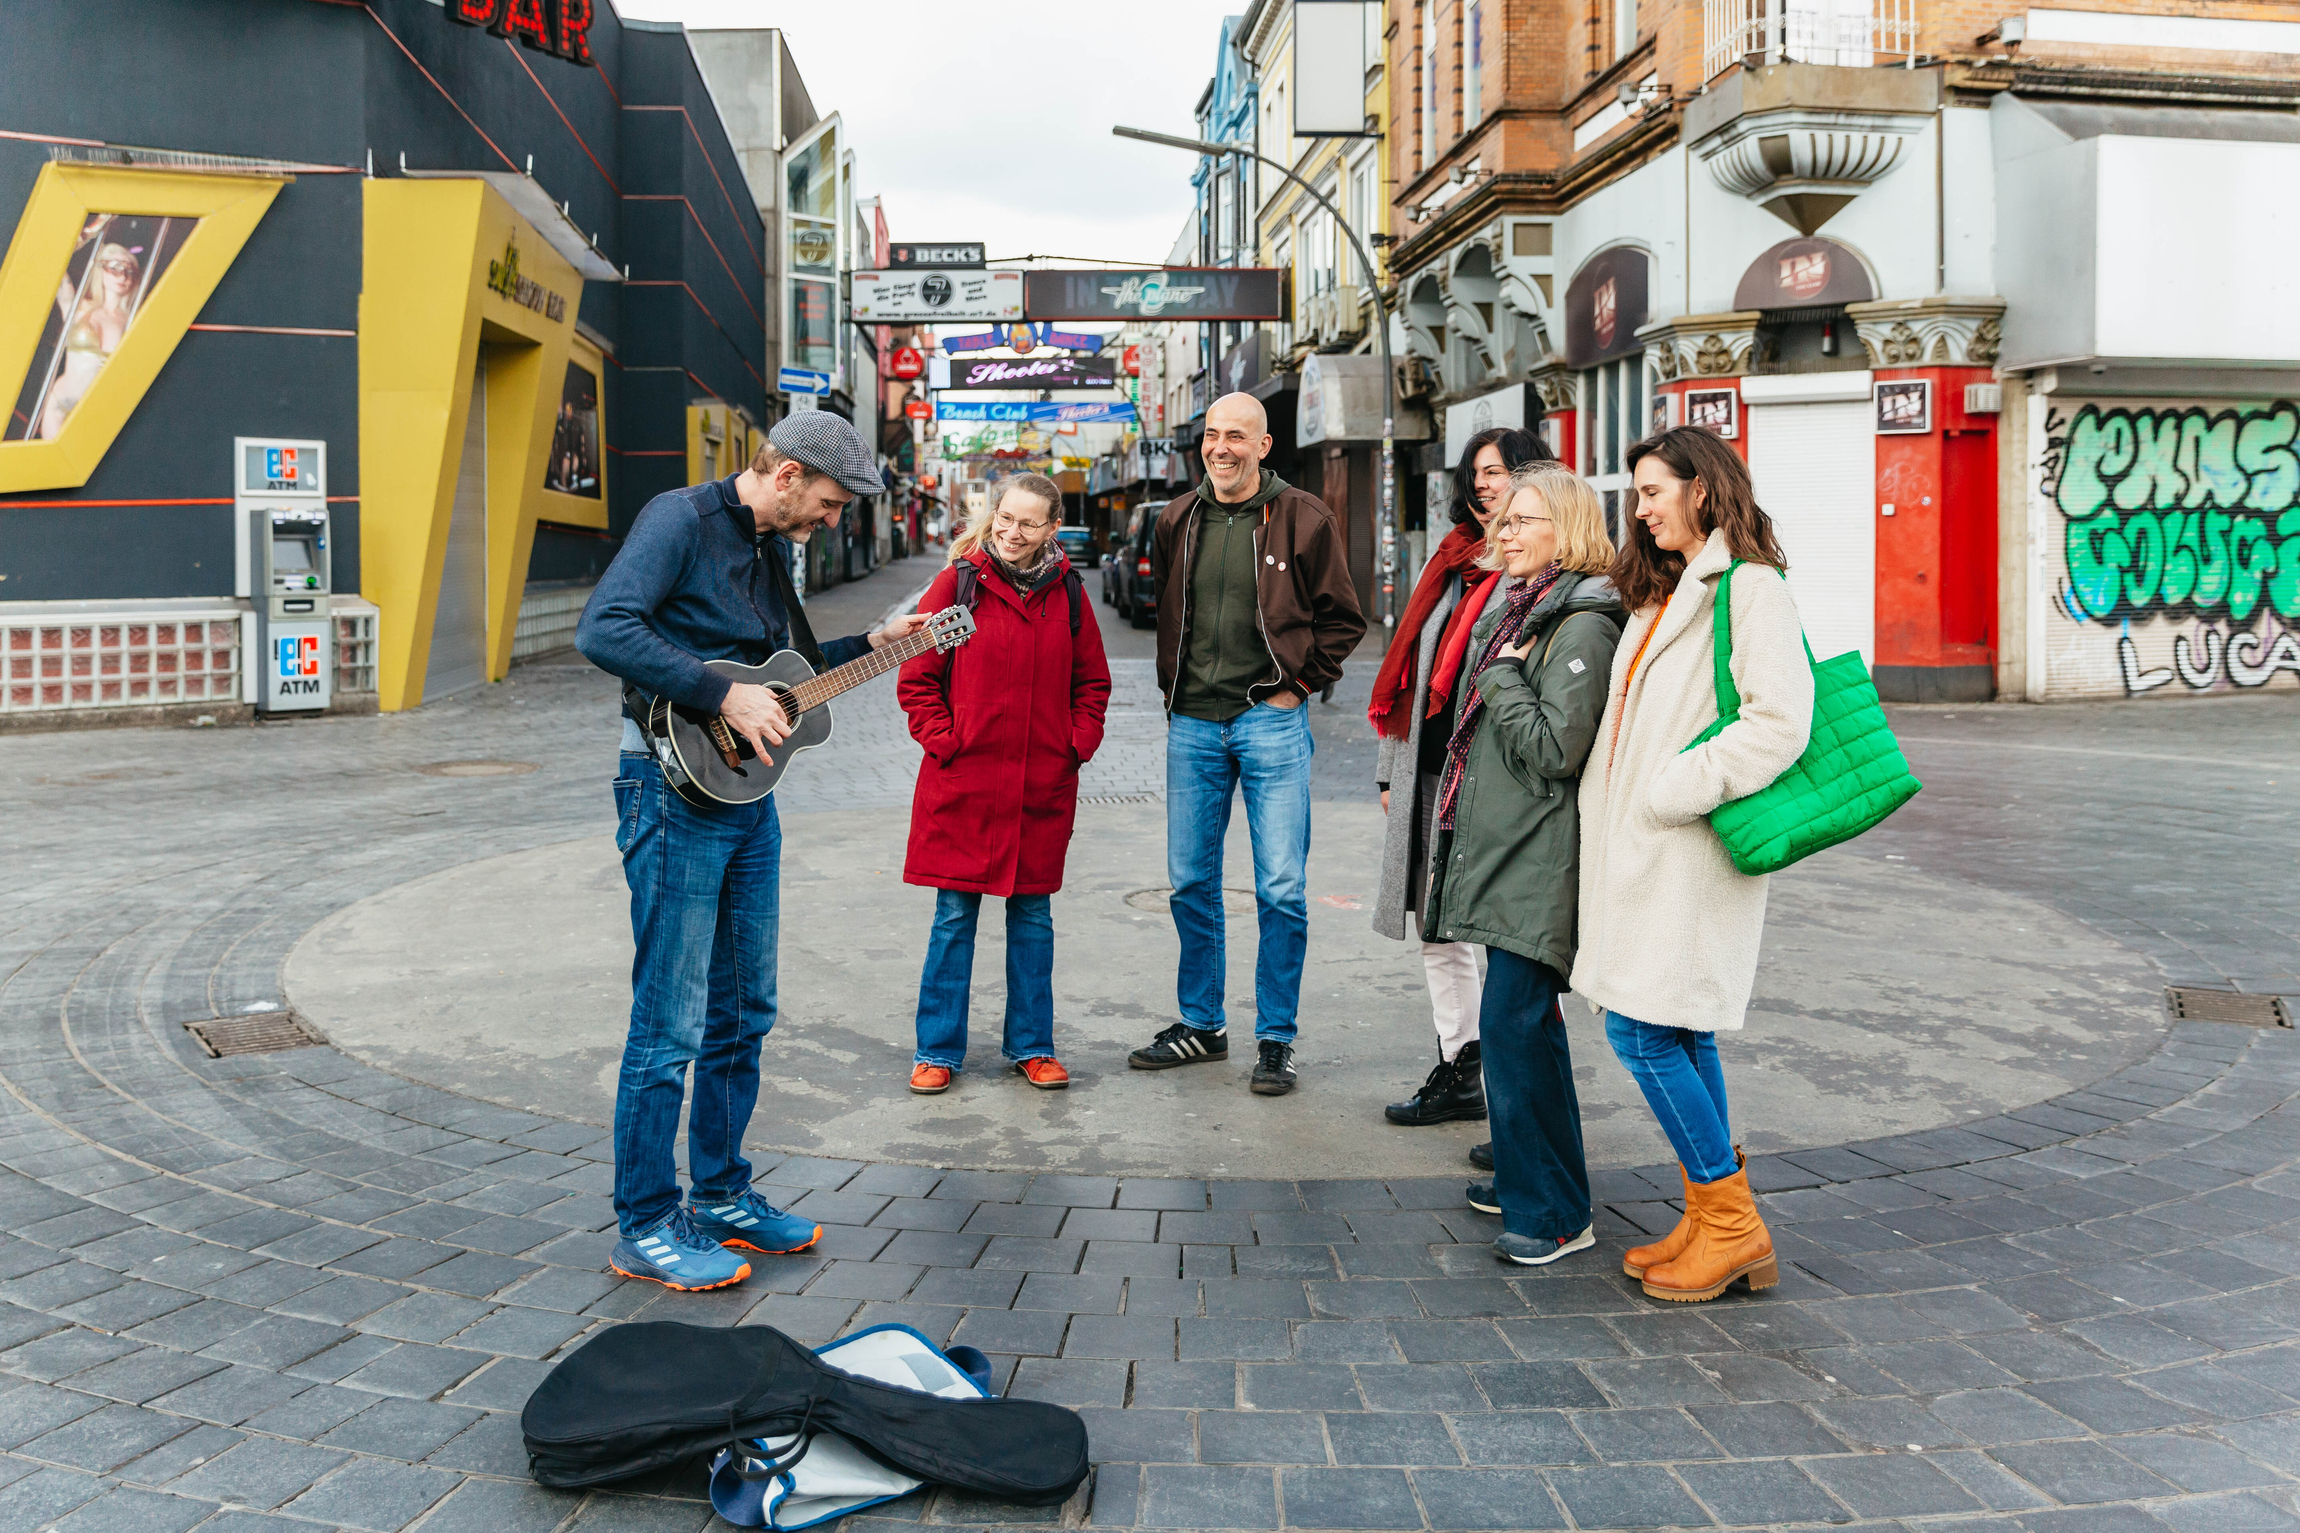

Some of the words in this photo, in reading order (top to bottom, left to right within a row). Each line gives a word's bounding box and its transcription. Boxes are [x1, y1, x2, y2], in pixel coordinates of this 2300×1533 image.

[914, 247, 981, 263] BECK'S
[940, 404, 986, 421] Beach
[990, 403, 1028, 421] Club
[267, 481, 298, 491] ATM
[280, 680, 320, 695] ATM
